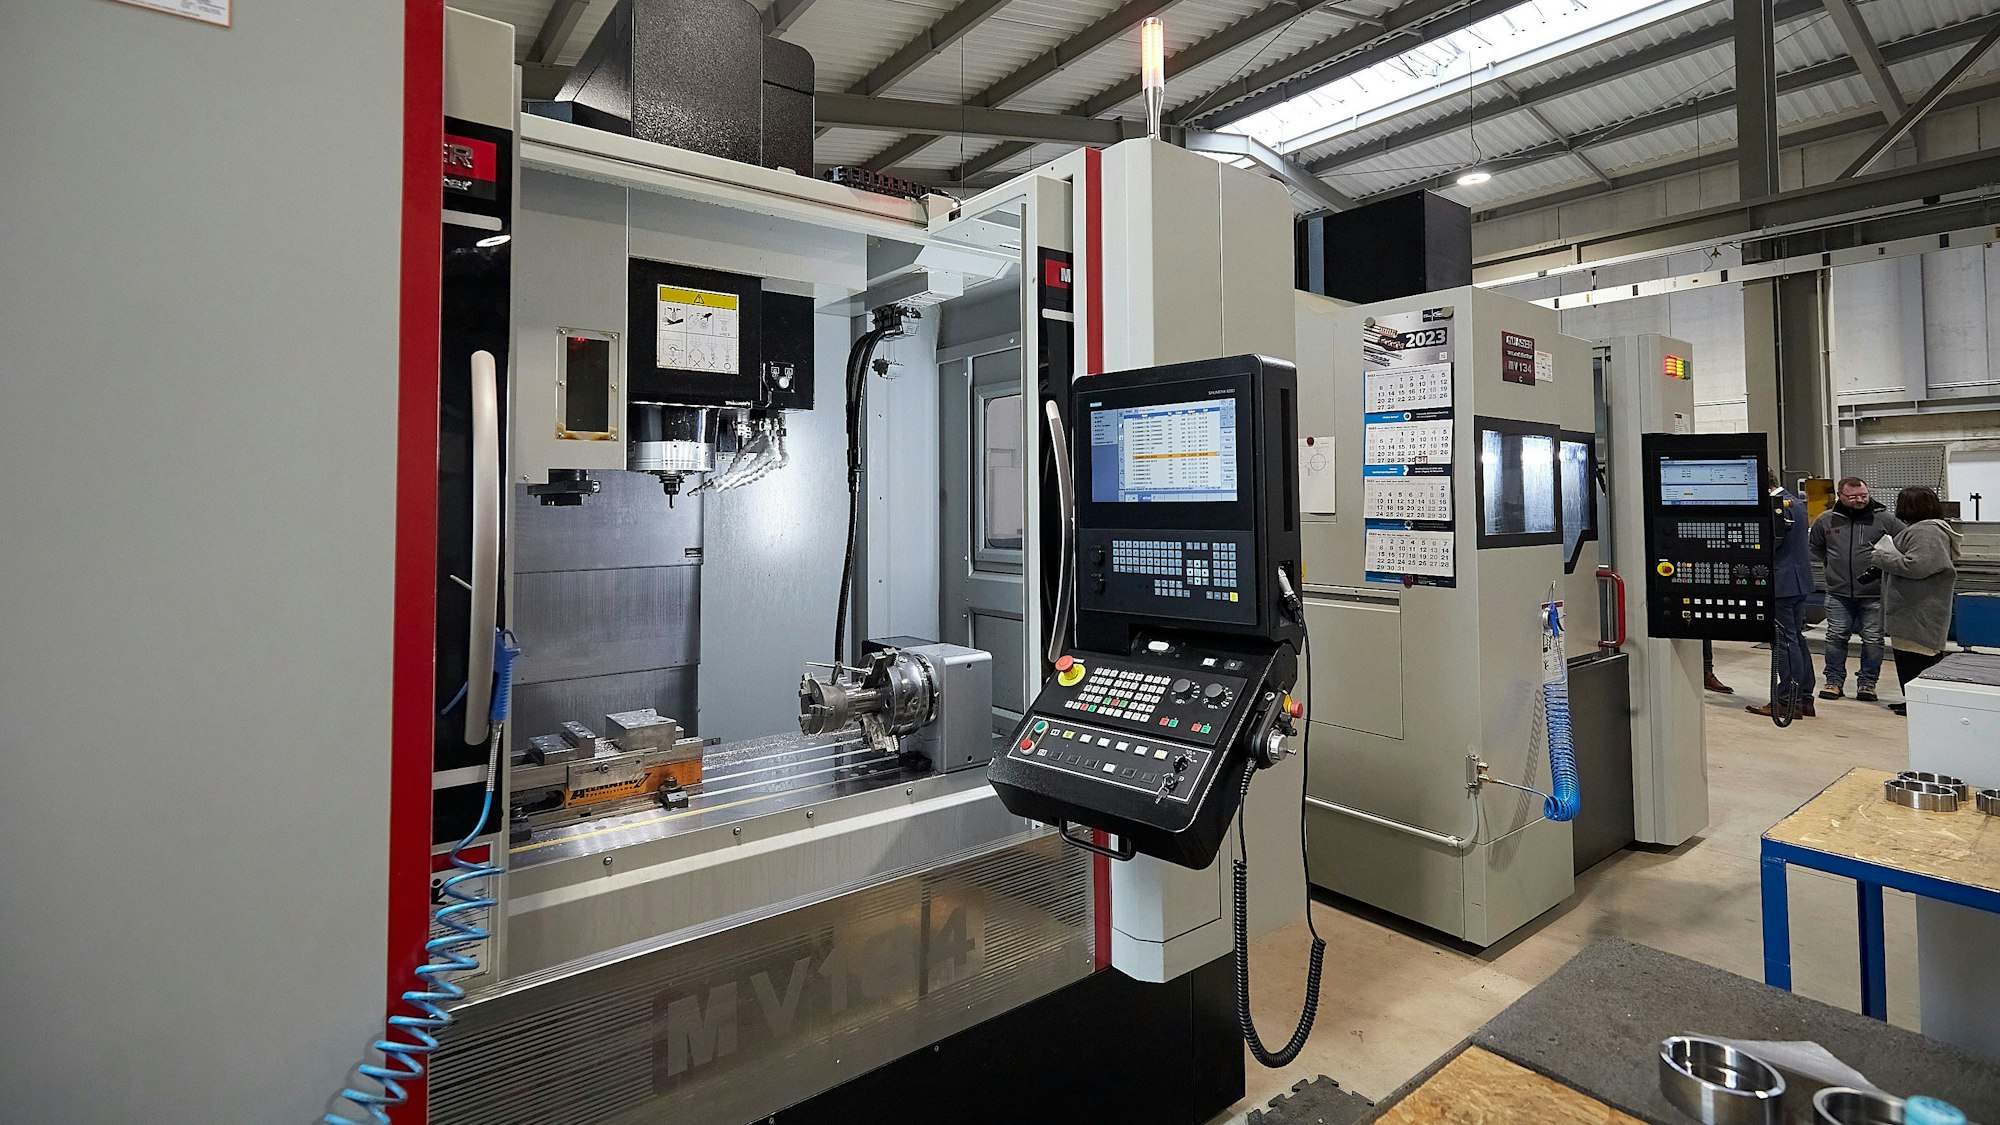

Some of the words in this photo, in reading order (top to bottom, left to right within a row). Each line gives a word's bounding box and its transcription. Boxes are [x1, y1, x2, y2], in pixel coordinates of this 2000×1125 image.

[444, 143, 473, 168] R
[1405, 330, 1446, 347] 2023
[668, 906, 975, 1077] MV14
